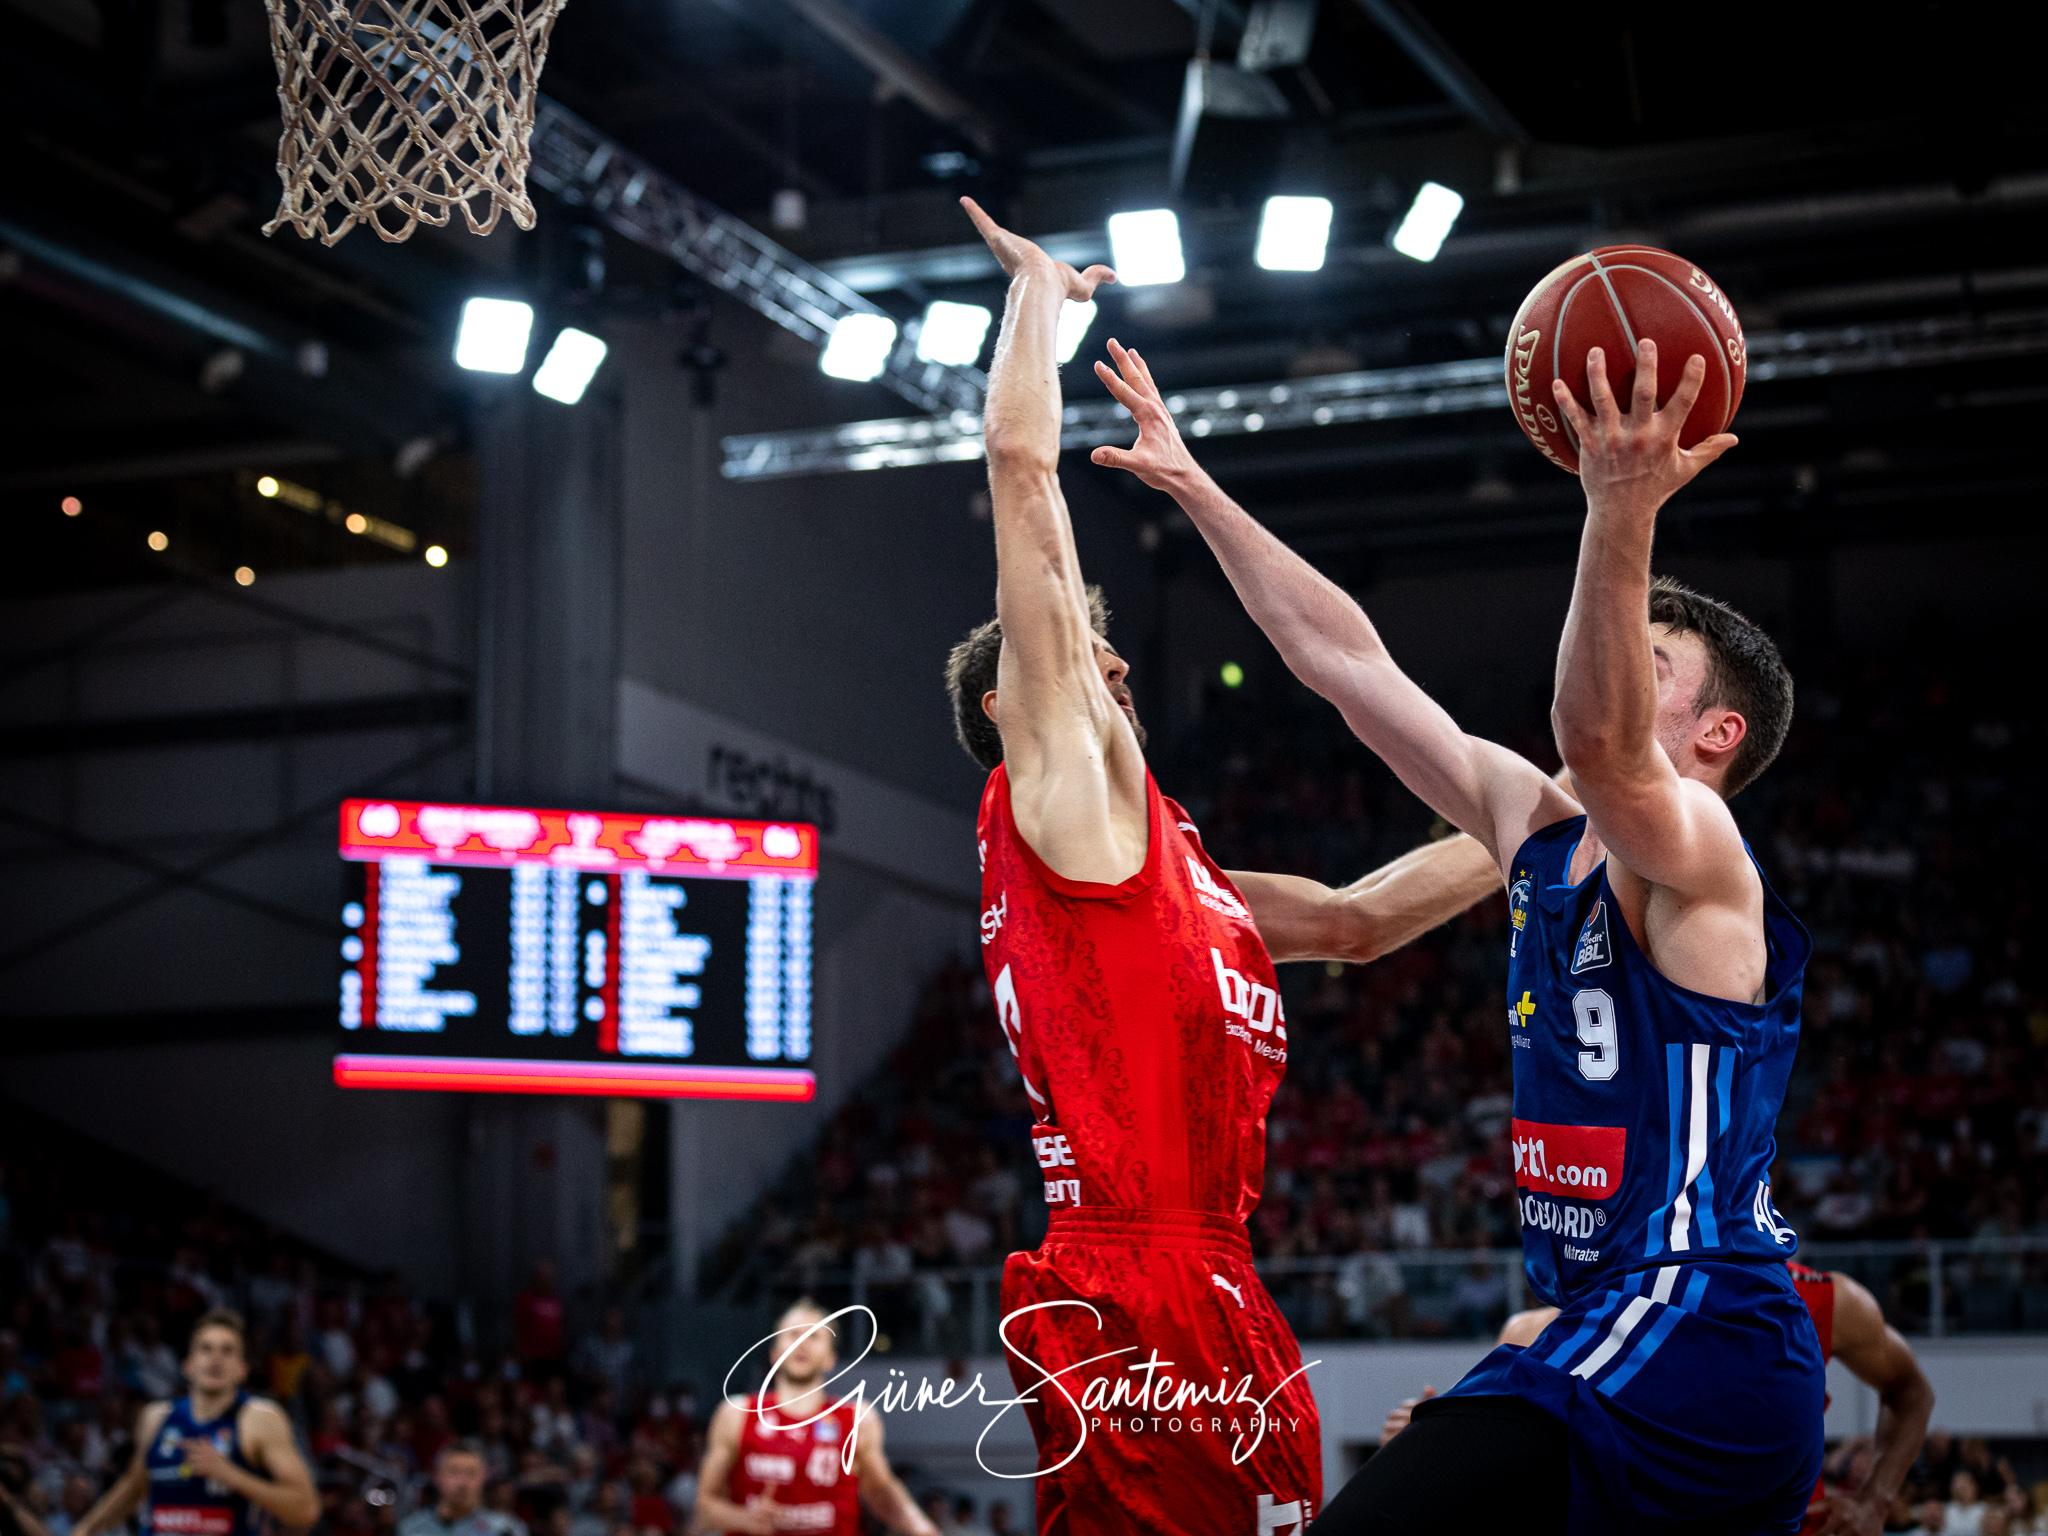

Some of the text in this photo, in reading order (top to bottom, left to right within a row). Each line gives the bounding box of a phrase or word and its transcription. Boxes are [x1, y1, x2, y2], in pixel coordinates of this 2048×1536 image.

[1514, 325, 1579, 474] SPALDIN
[1576, 943, 1604, 968] BBL
[1572, 988, 1618, 1080] 9
